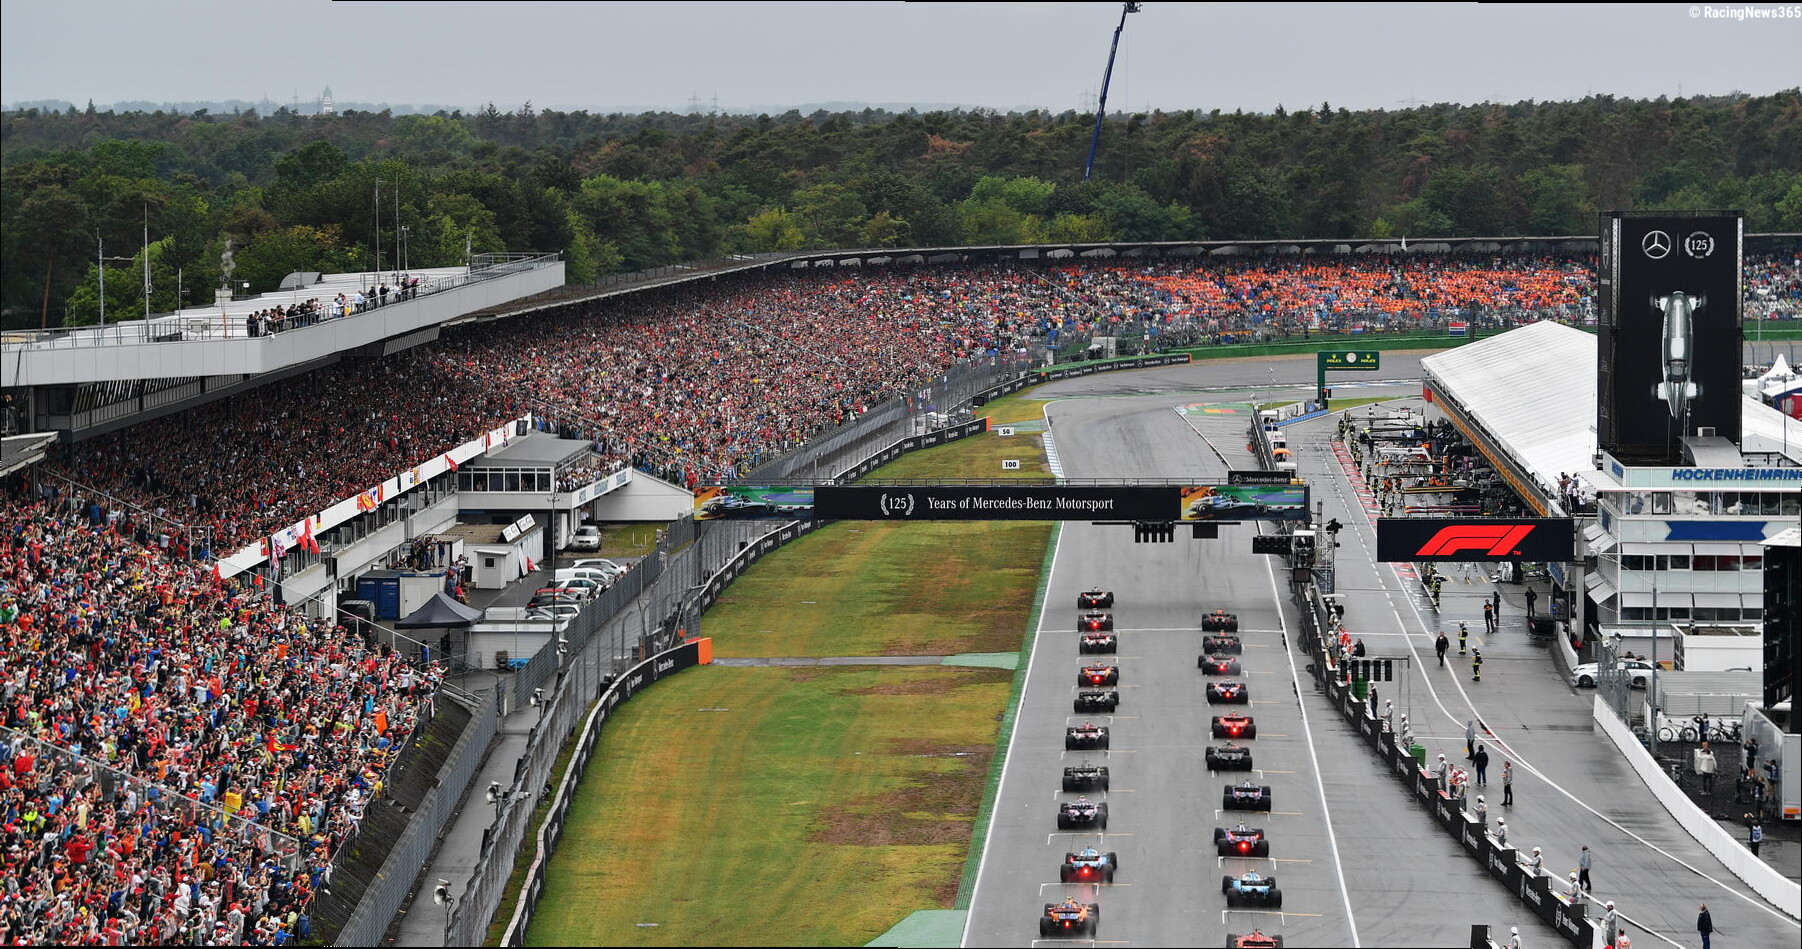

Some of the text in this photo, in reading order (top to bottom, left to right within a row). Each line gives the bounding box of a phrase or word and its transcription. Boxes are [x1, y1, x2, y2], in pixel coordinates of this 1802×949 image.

[1691, 240, 1708, 250] 125
[1246, 474, 1287, 484] Mercedes-Benz
[1672, 469, 1801, 480] HOCKENHEIMRIN
[889, 497, 1114, 512] 125 Years of Mercedes-Benz Motorsport
[1415, 525, 1536, 555] F1
